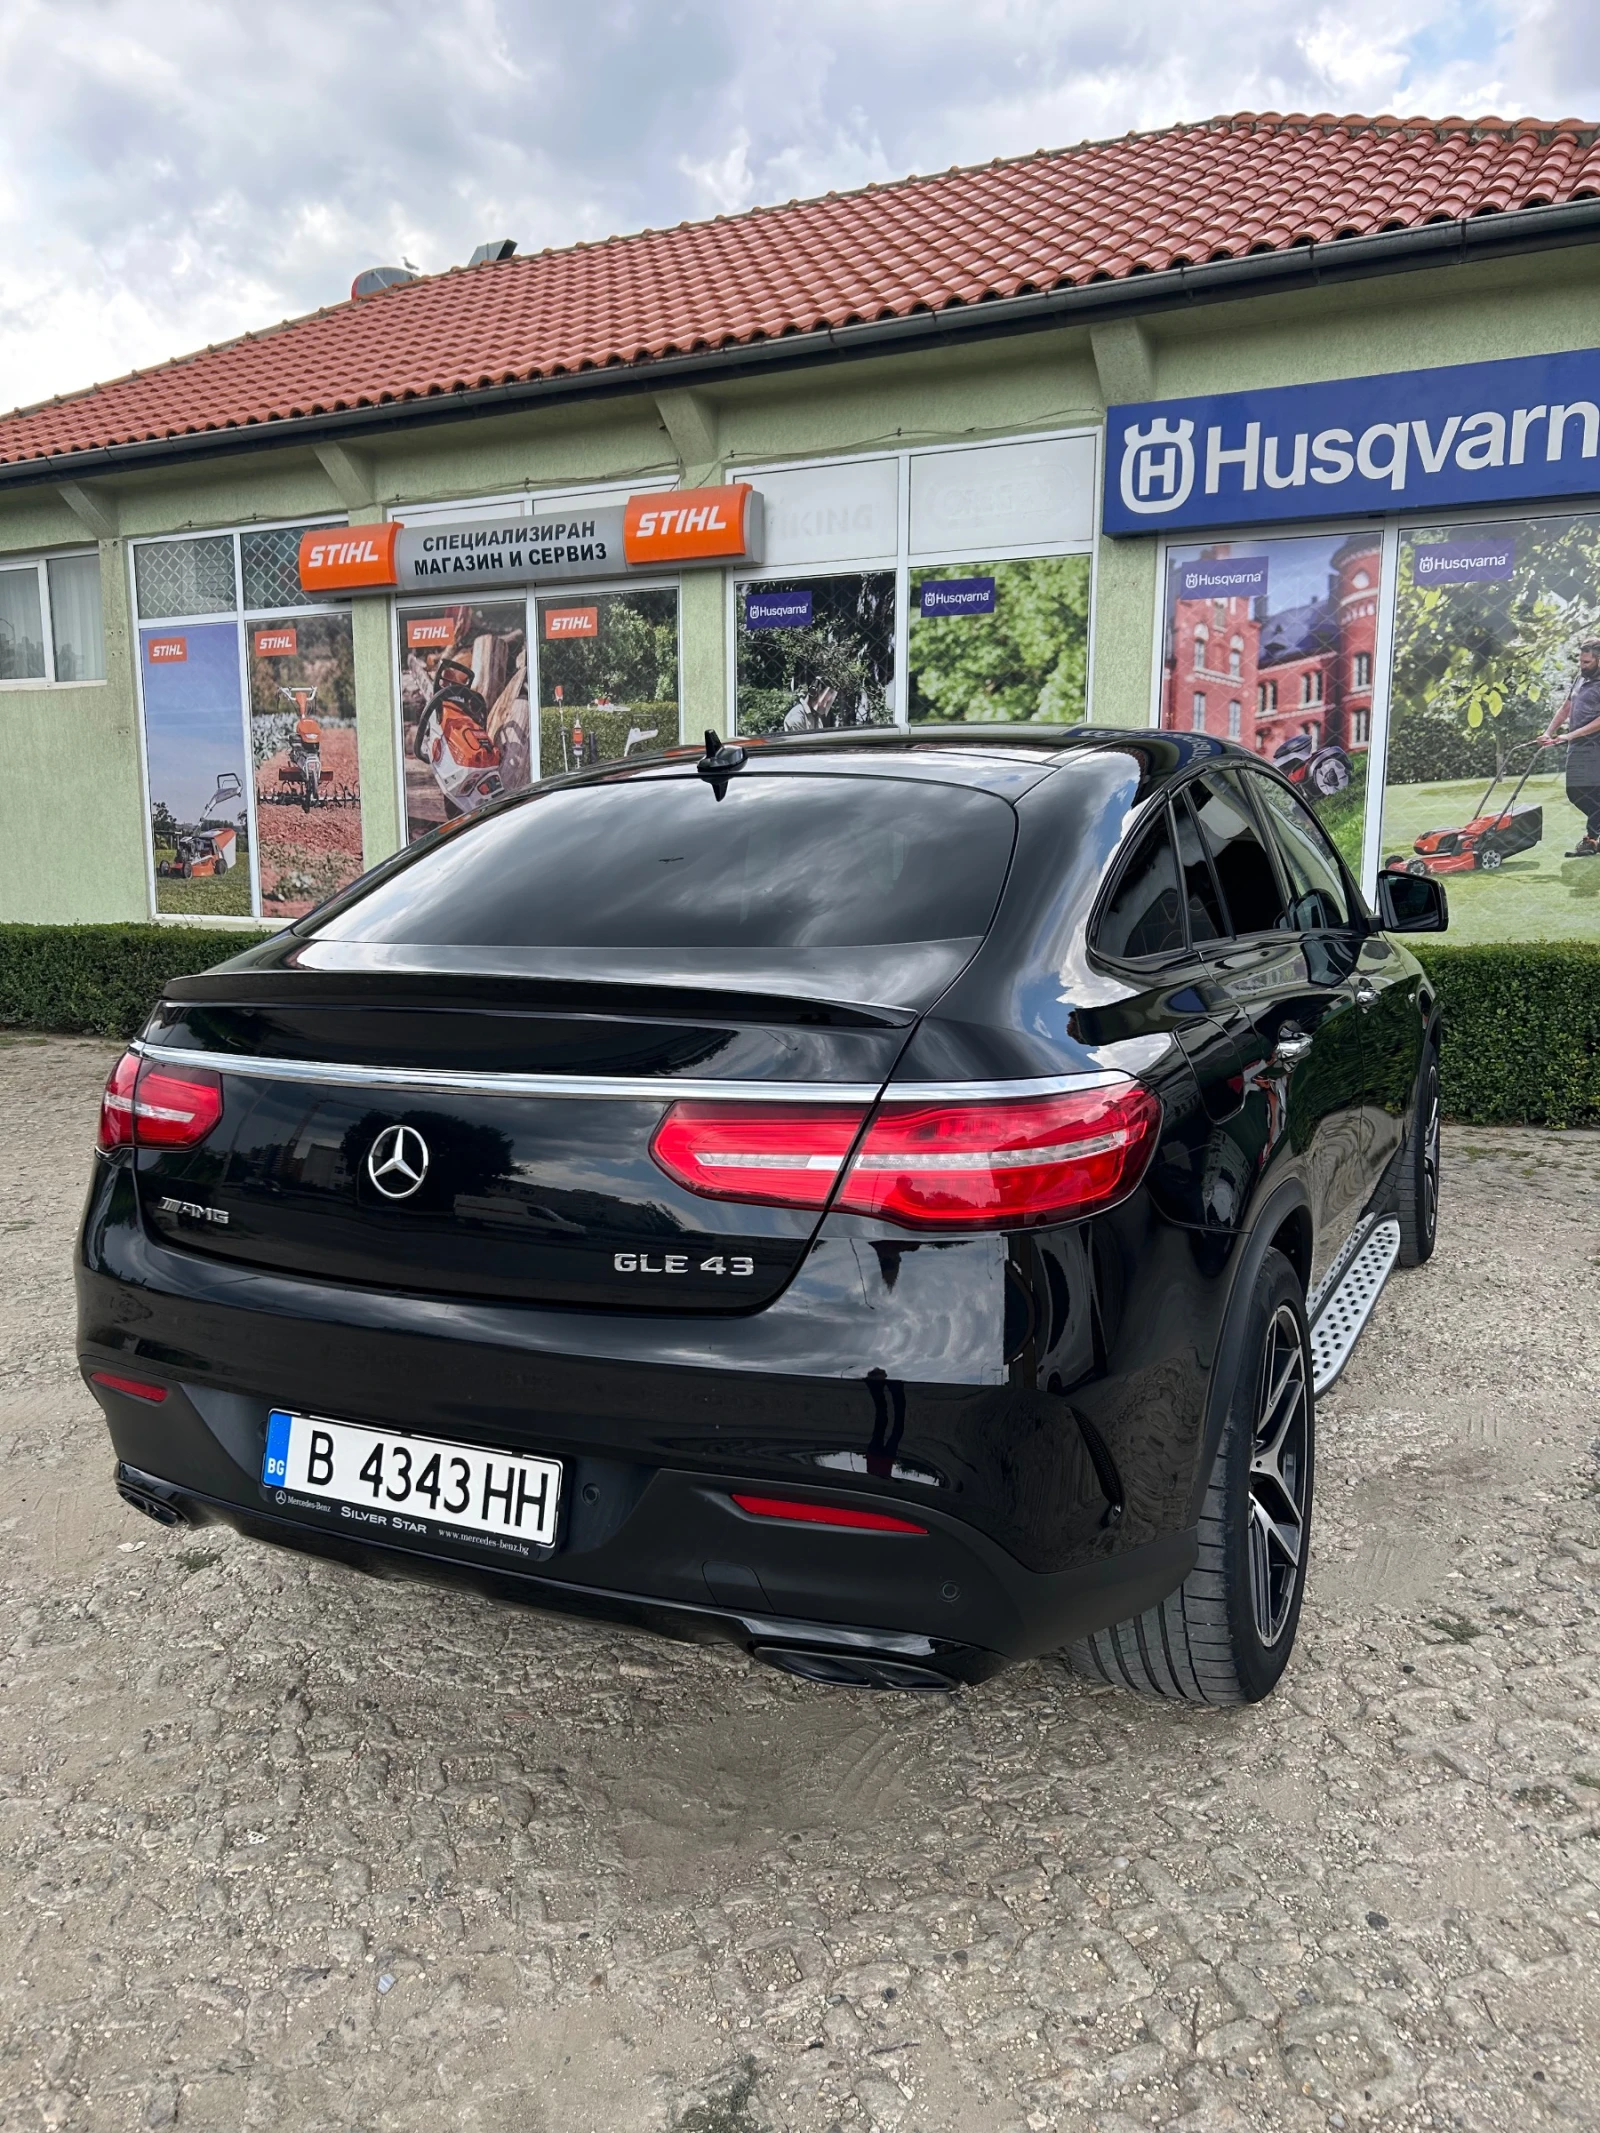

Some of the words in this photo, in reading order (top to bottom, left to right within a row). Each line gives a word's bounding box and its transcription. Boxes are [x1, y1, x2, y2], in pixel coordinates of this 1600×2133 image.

[1204, 401, 1600, 494] Husqvarn
[636, 505, 727, 538] STIHL
[422, 520, 596, 552] СПЕЦИАЛИЗИРАН
[308, 540, 380, 568] STIHL
[414, 551, 504, 576] МАГАЗИН
[510, 549, 523, 568] И
[528, 542, 607, 567] СЕРВИЗ
[1434, 555, 1506, 570] Husqvarna
[1198, 572, 1262, 586] Husqvarna
[936, 592, 990, 605] Husqvarna
[759, 604, 808, 617] Husqvarna
[411, 625, 450, 640] STIHL
[550, 616, 593, 631] STIHL
[153, 643, 184, 657] STIHL
[260, 636, 292, 650] STIHL
[614, 1253, 689, 1274] GLE
[700, 1256, 754, 1276] 43
[267, 1457, 285, 1477] BG
[307, 1429, 335, 1487] B
[358, 1442, 471, 1514] 4343
[481, 1462, 549, 1532] HH
[287, 1495, 332, 1513] Mercedes-Benz
[438, 1528, 530, 1556] www.mercedes-benz.bg
